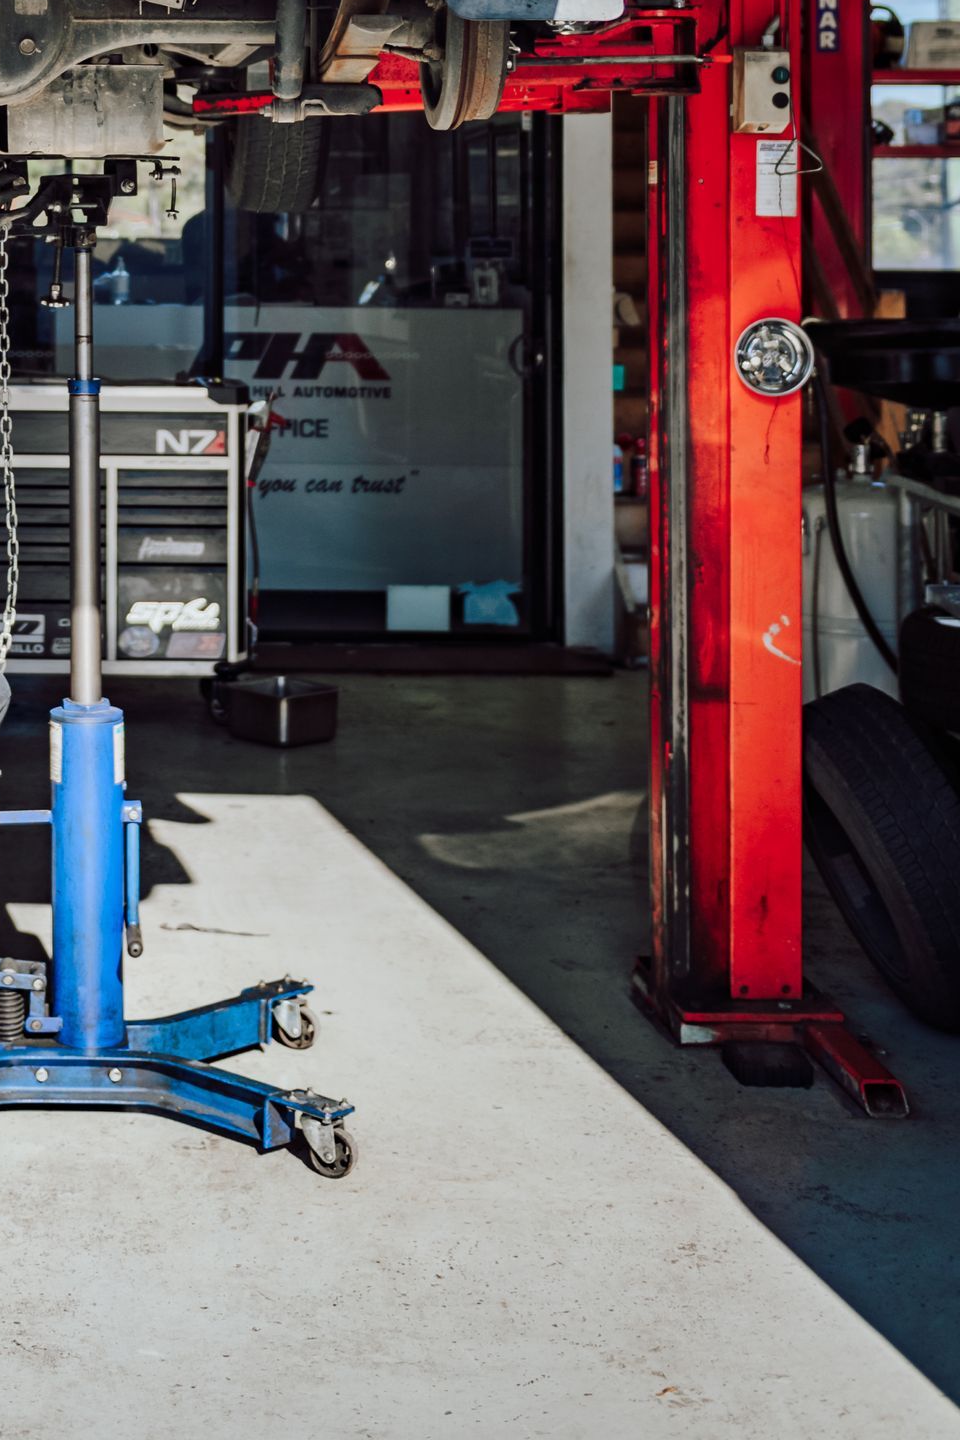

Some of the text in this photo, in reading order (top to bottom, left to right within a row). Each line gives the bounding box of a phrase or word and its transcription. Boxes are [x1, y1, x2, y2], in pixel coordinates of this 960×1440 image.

[293, 386, 391, 398] AUTOMOTIVE
[155, 429, 217, 454] N7
[258, 477, 297, 499] you
[304, 477, 344, 494] can
